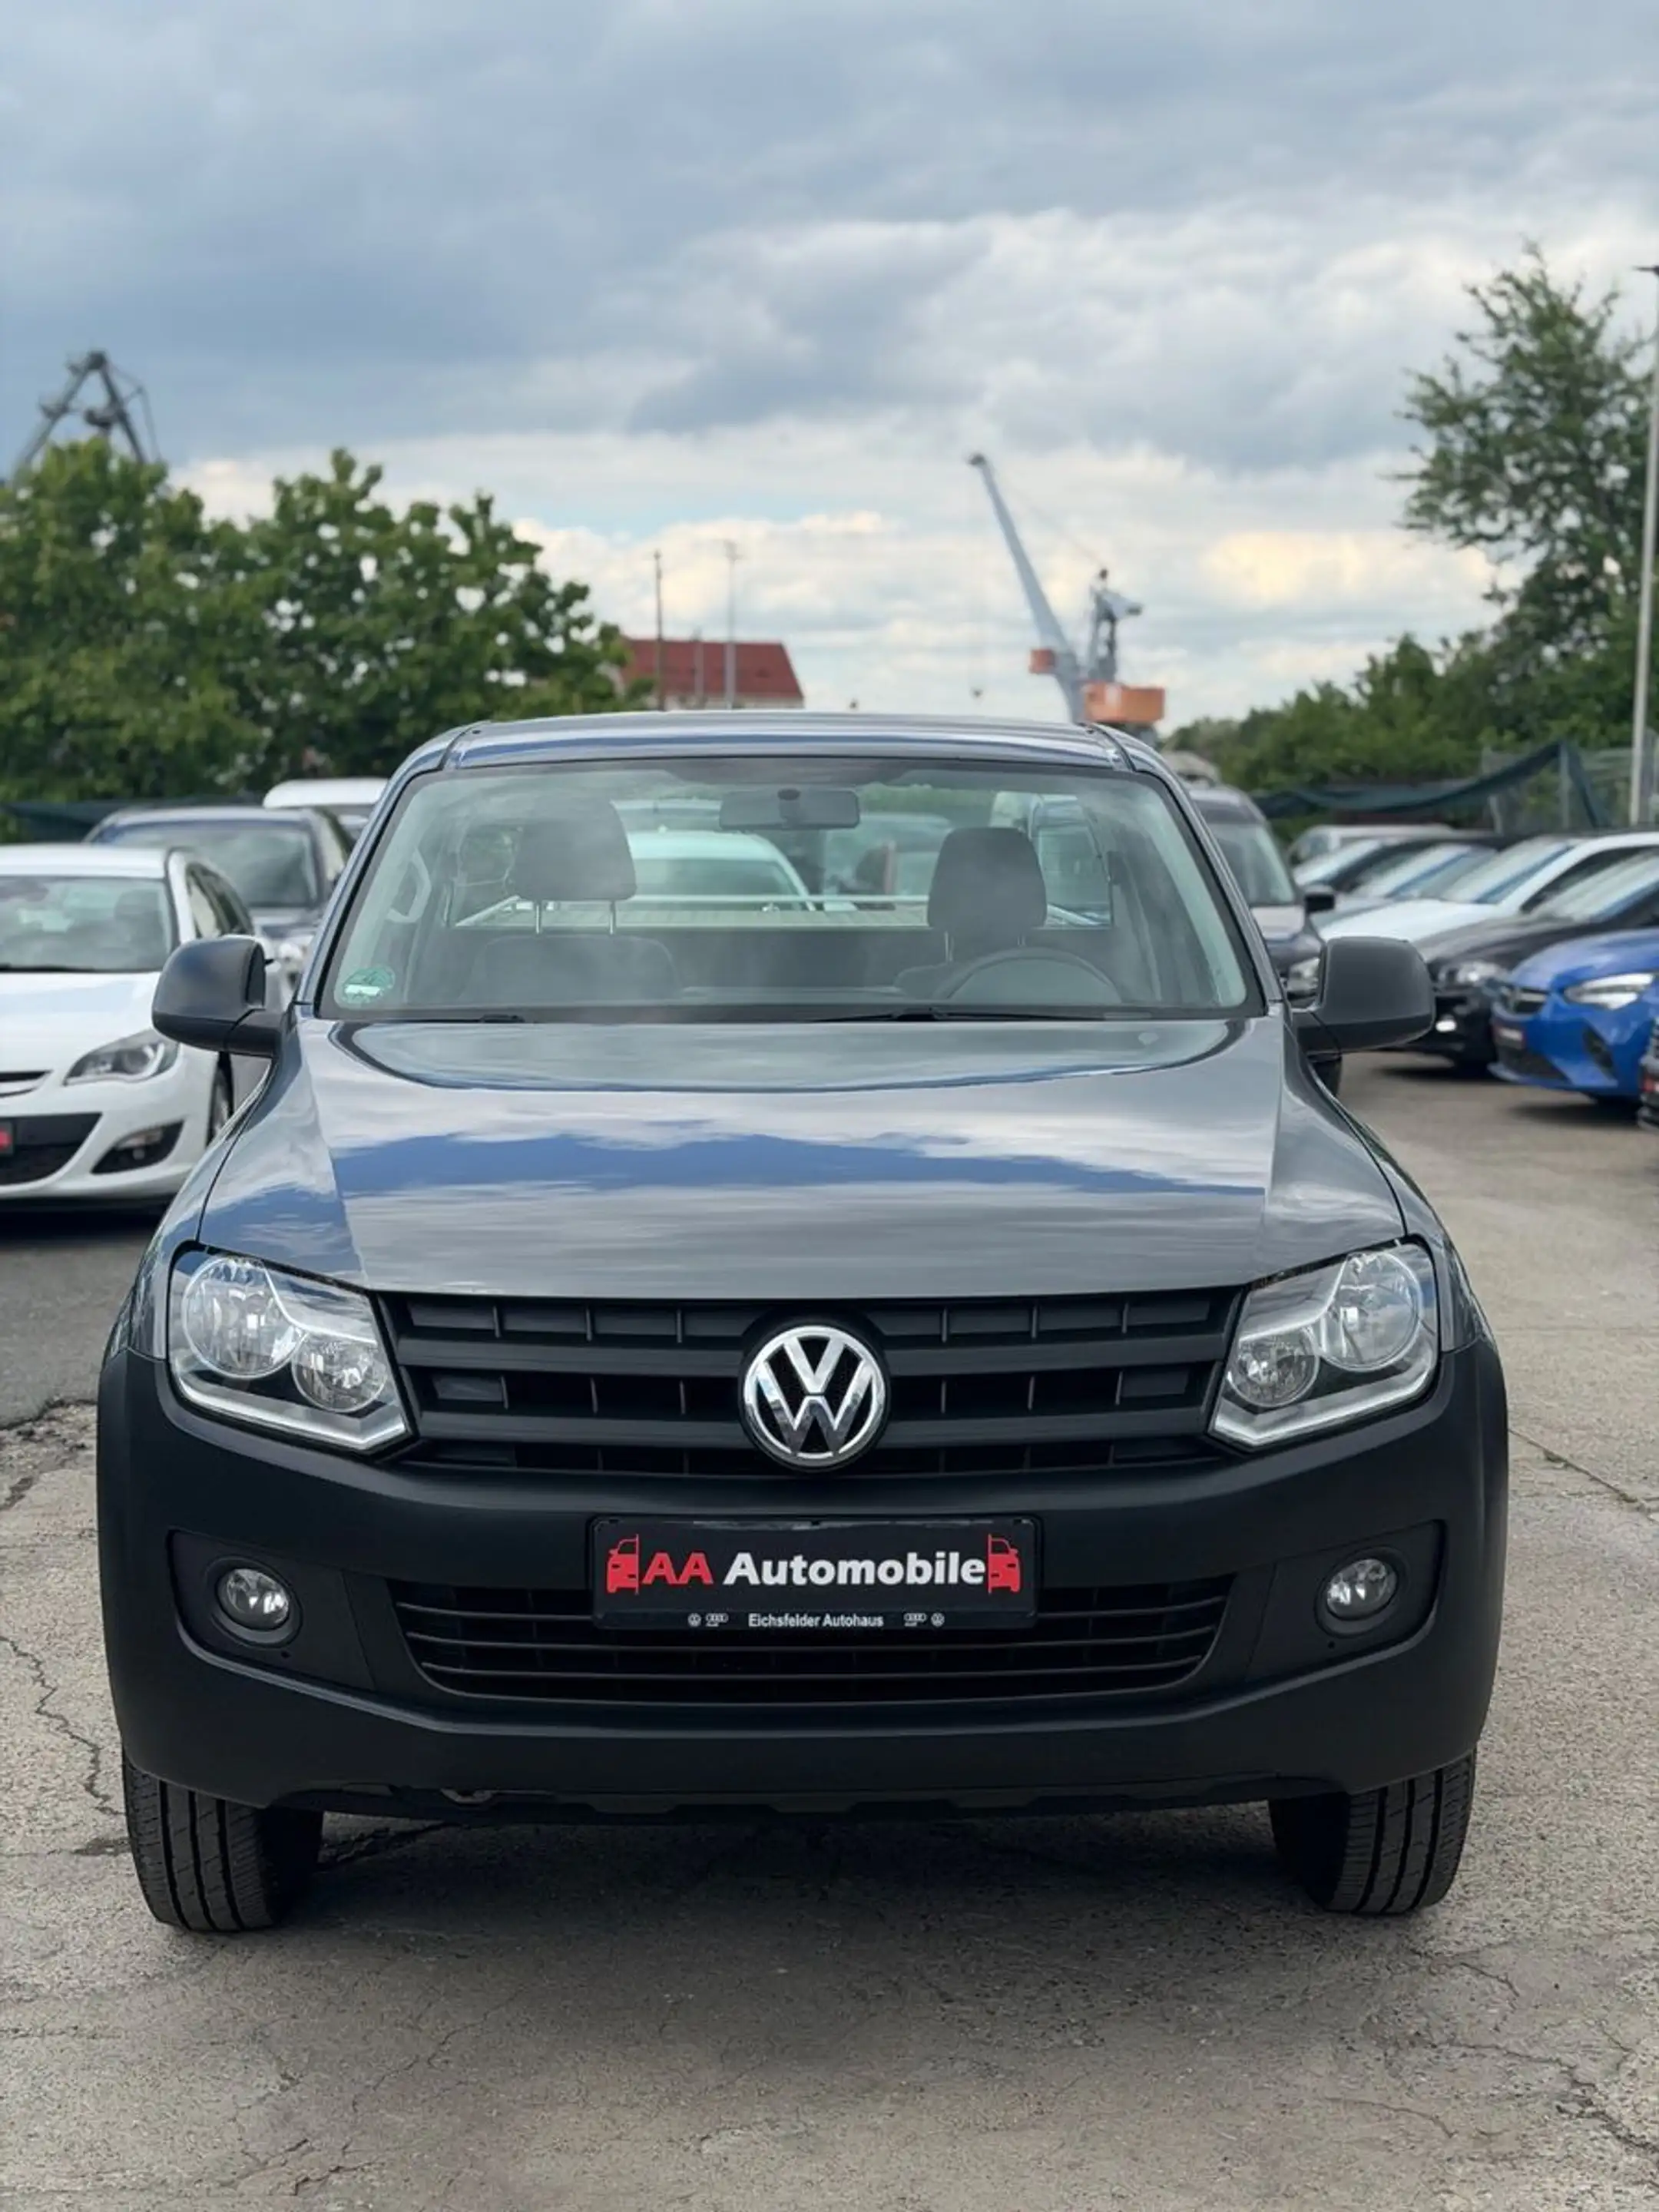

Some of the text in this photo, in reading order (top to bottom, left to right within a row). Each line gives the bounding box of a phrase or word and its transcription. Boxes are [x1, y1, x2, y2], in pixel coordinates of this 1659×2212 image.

[641, 1551, 986, 1585] AA Automobile
[748, 1613, 883, 1628] Eichsfelder Autohaus
